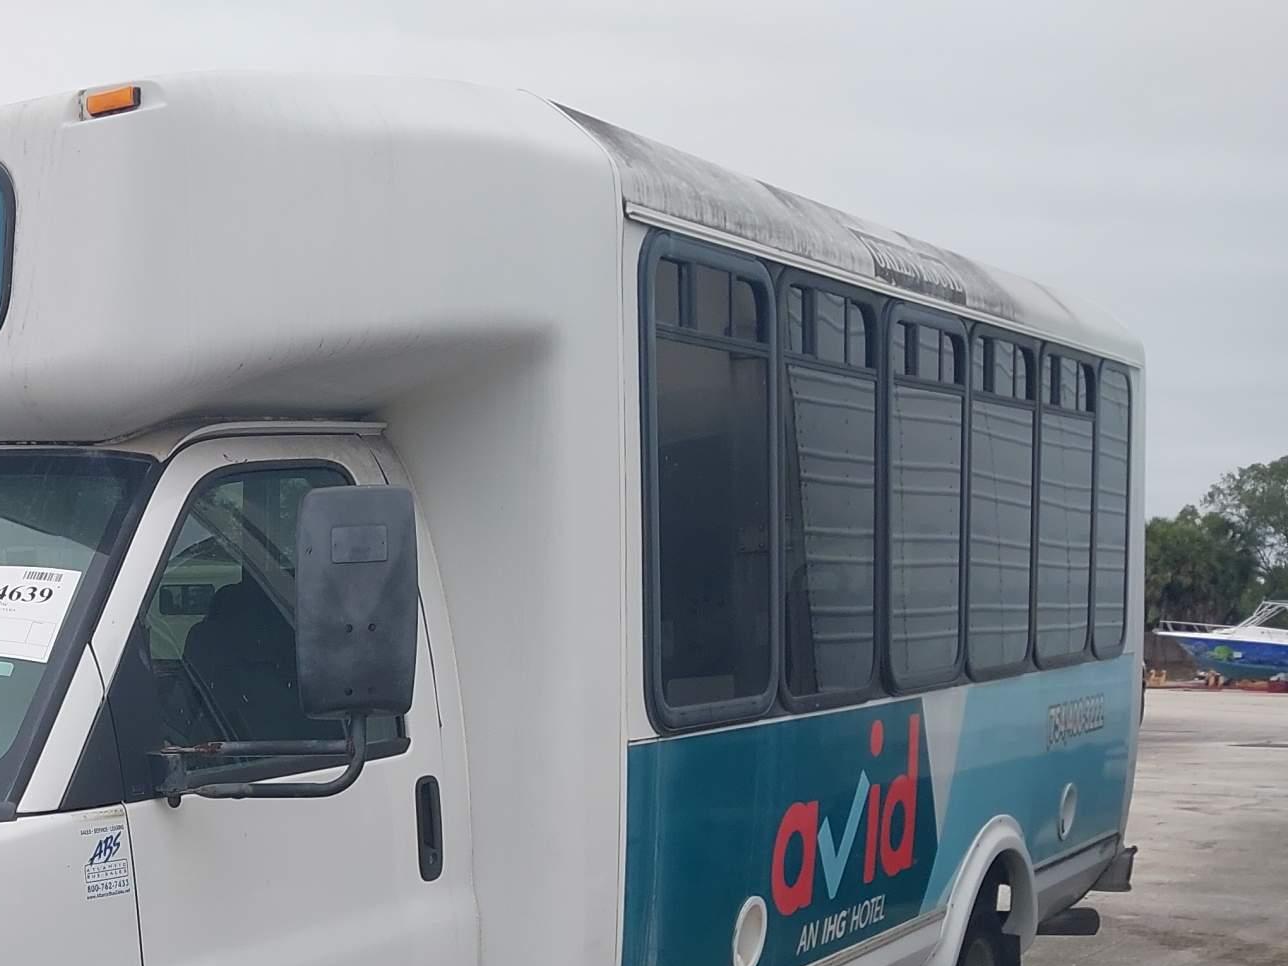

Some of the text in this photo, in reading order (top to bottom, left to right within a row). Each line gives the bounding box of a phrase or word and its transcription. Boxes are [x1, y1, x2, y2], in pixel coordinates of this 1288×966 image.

[770, 713, 921, 917] avid
[88, 831, 122, 866] ABS
[796, 894, 886, 956] AN IHG HOTEL
